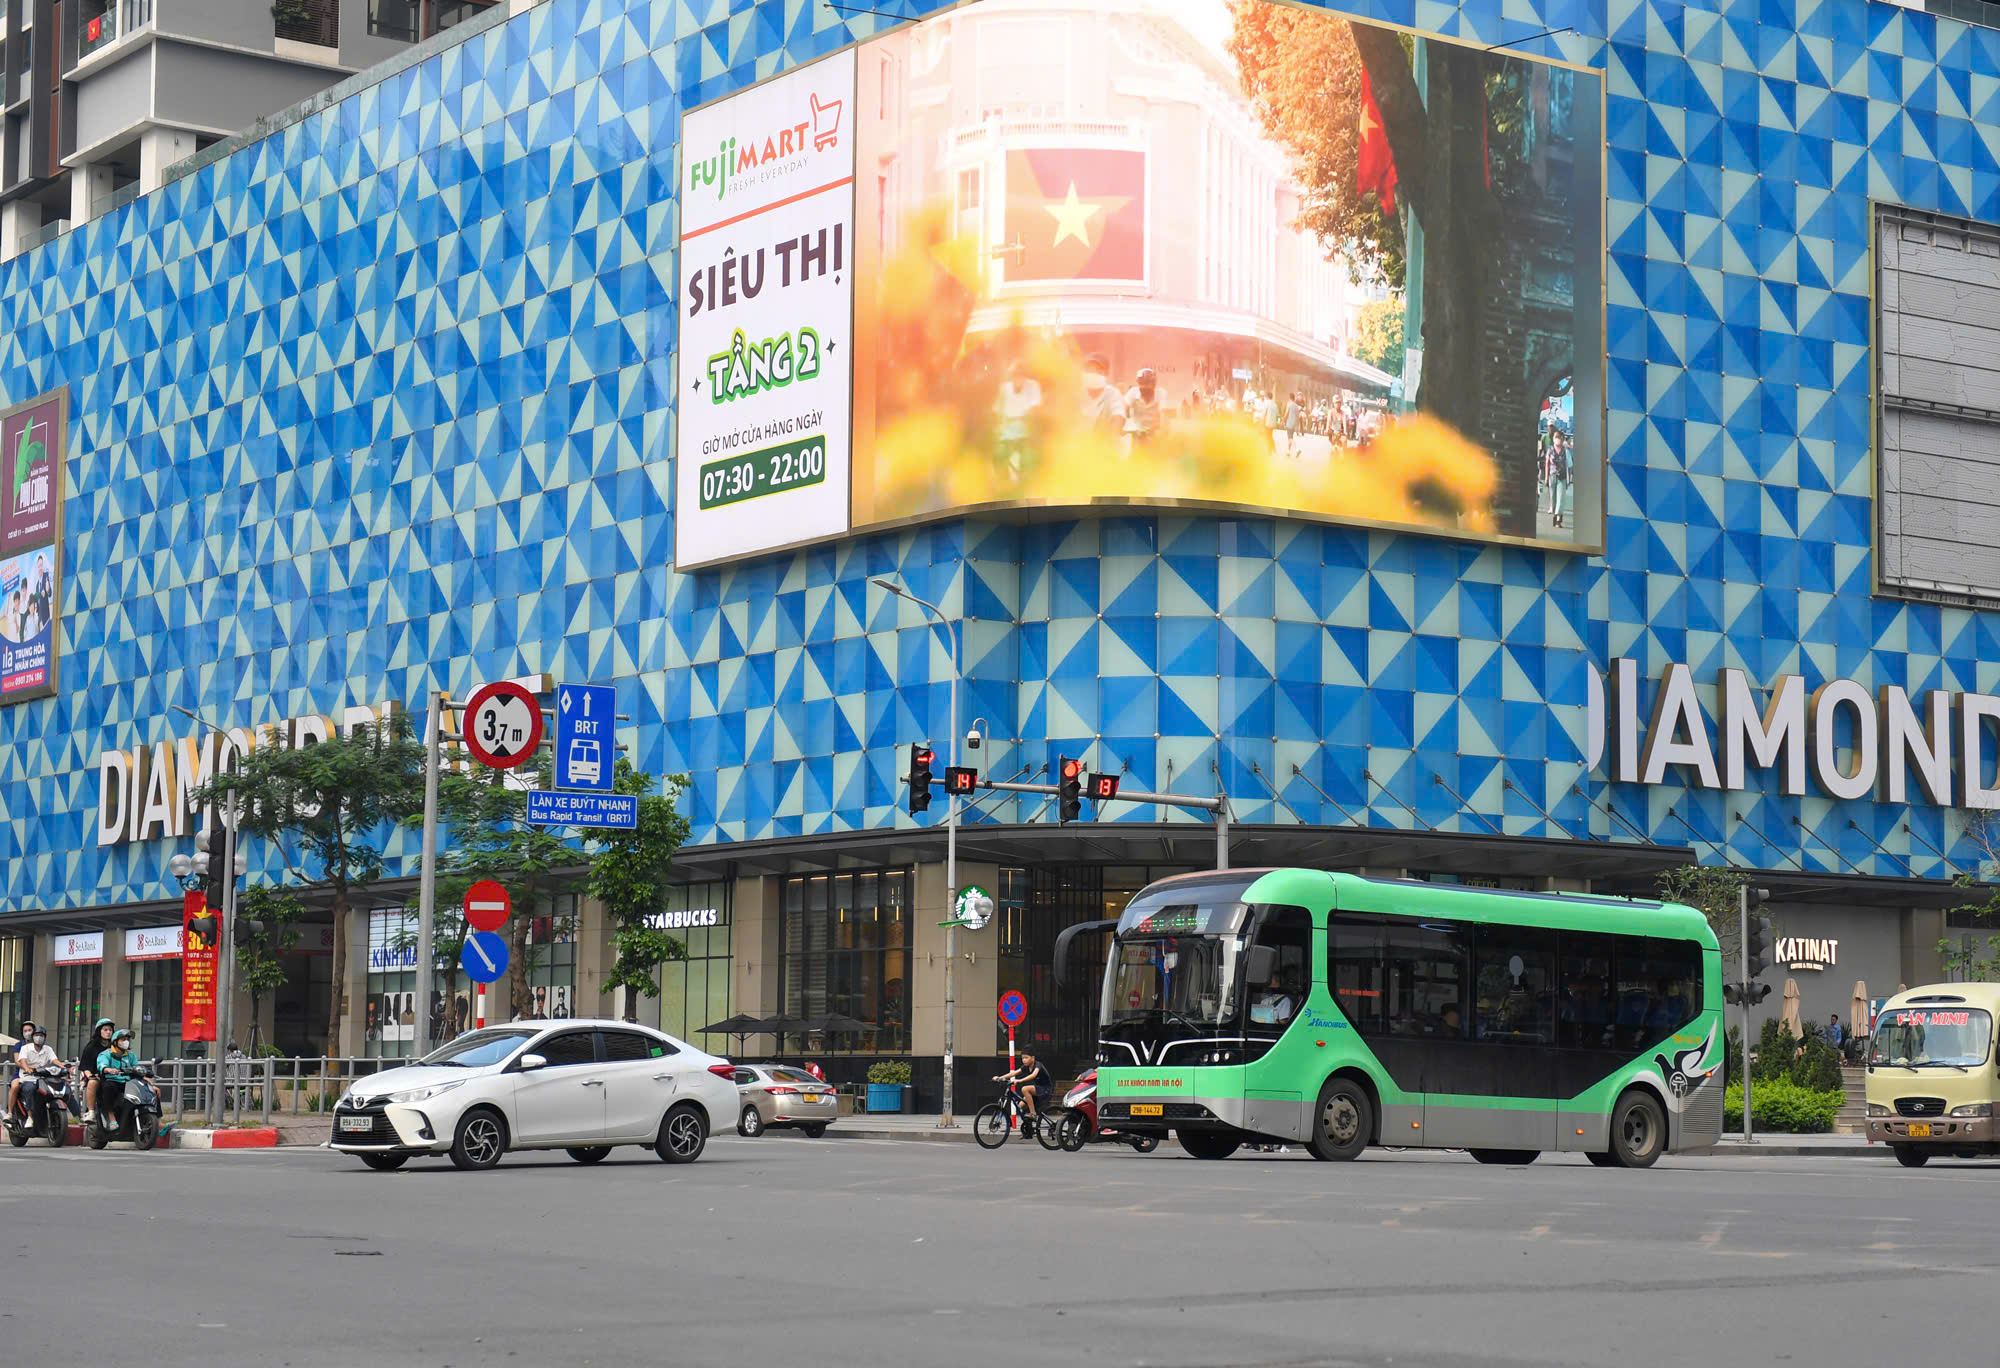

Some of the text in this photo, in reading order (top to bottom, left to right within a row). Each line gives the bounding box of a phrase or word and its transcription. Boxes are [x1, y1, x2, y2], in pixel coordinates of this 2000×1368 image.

[728, 157, 808, 195] FRESH EVERYDAY
[688, 223, 843, 318] SIÊU THỊ
[708, 328, 819, 403] TẦNG 2
[702, 409, 823, 455] GIỜ MỞ CỬA HÀNG NGÀY
[703, 463, 754, 501] 07:30
[770, 446, 823, 485] 22:00
[15, 646, 33, 660] TRUNG
[512, 727, 522, 742] m
[574, 719, 599, 735] BRT
[957, 773, 971, 789] 14
[1098, 778, 1112, 796] 13
[532, 794, 631, 812] LÀN XE BUÝT NHANH
[531, 810, 632, 823] Bus Rapid Transit (BRT)
[372, 944, 400, 968] KÍNH
[1775, 937, 1838, 965] KATINAT
[1930, 1012, 1969, 1026] MINH
